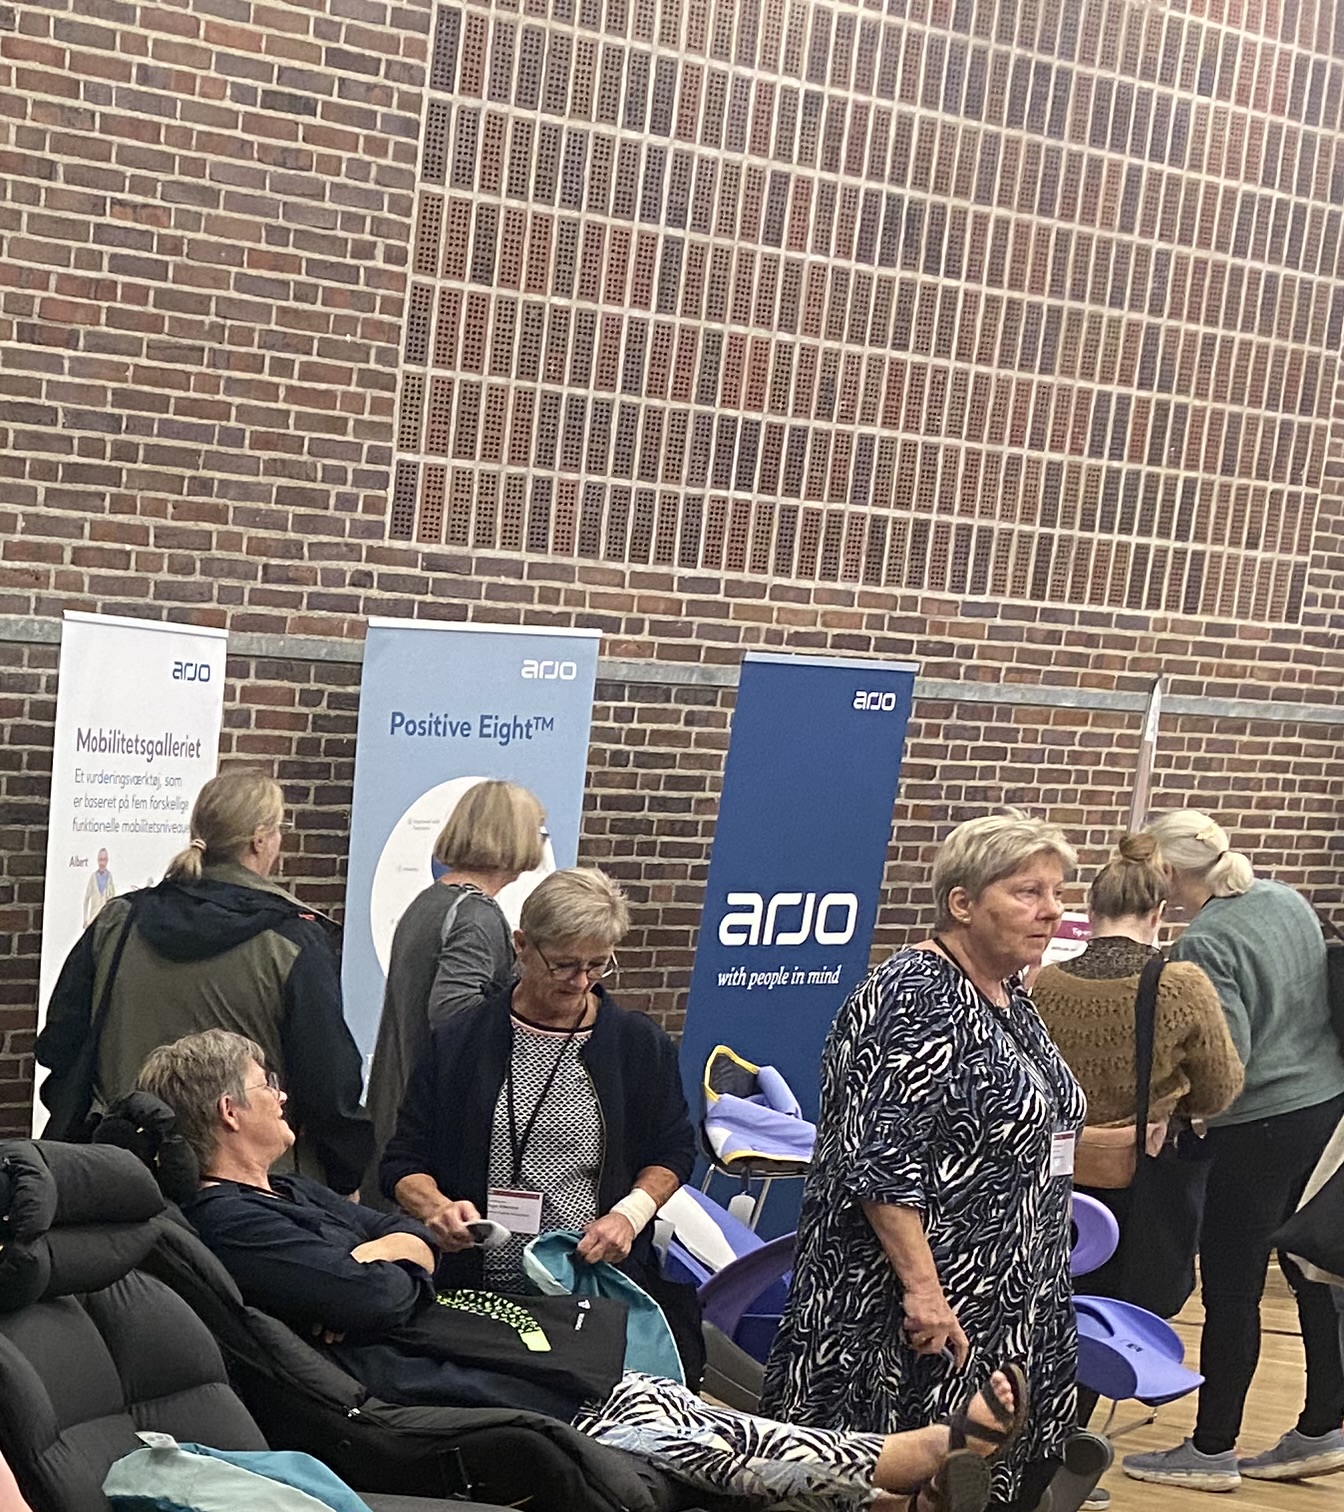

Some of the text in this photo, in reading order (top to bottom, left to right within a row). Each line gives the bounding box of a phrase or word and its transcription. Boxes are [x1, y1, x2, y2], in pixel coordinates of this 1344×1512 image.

[389, 711, 472, 738] Positive
[76, 727, 201, 763] Mobilitetsgalleriet
[164, 775, 183, 788] som
[73, 795, 83, 808] er
[84, 793, 117, 809] baseret
[118, 793, 130, 813] på
[131, 793, 148, 810] fem
[717, 964, 842, 991] with people in mind
